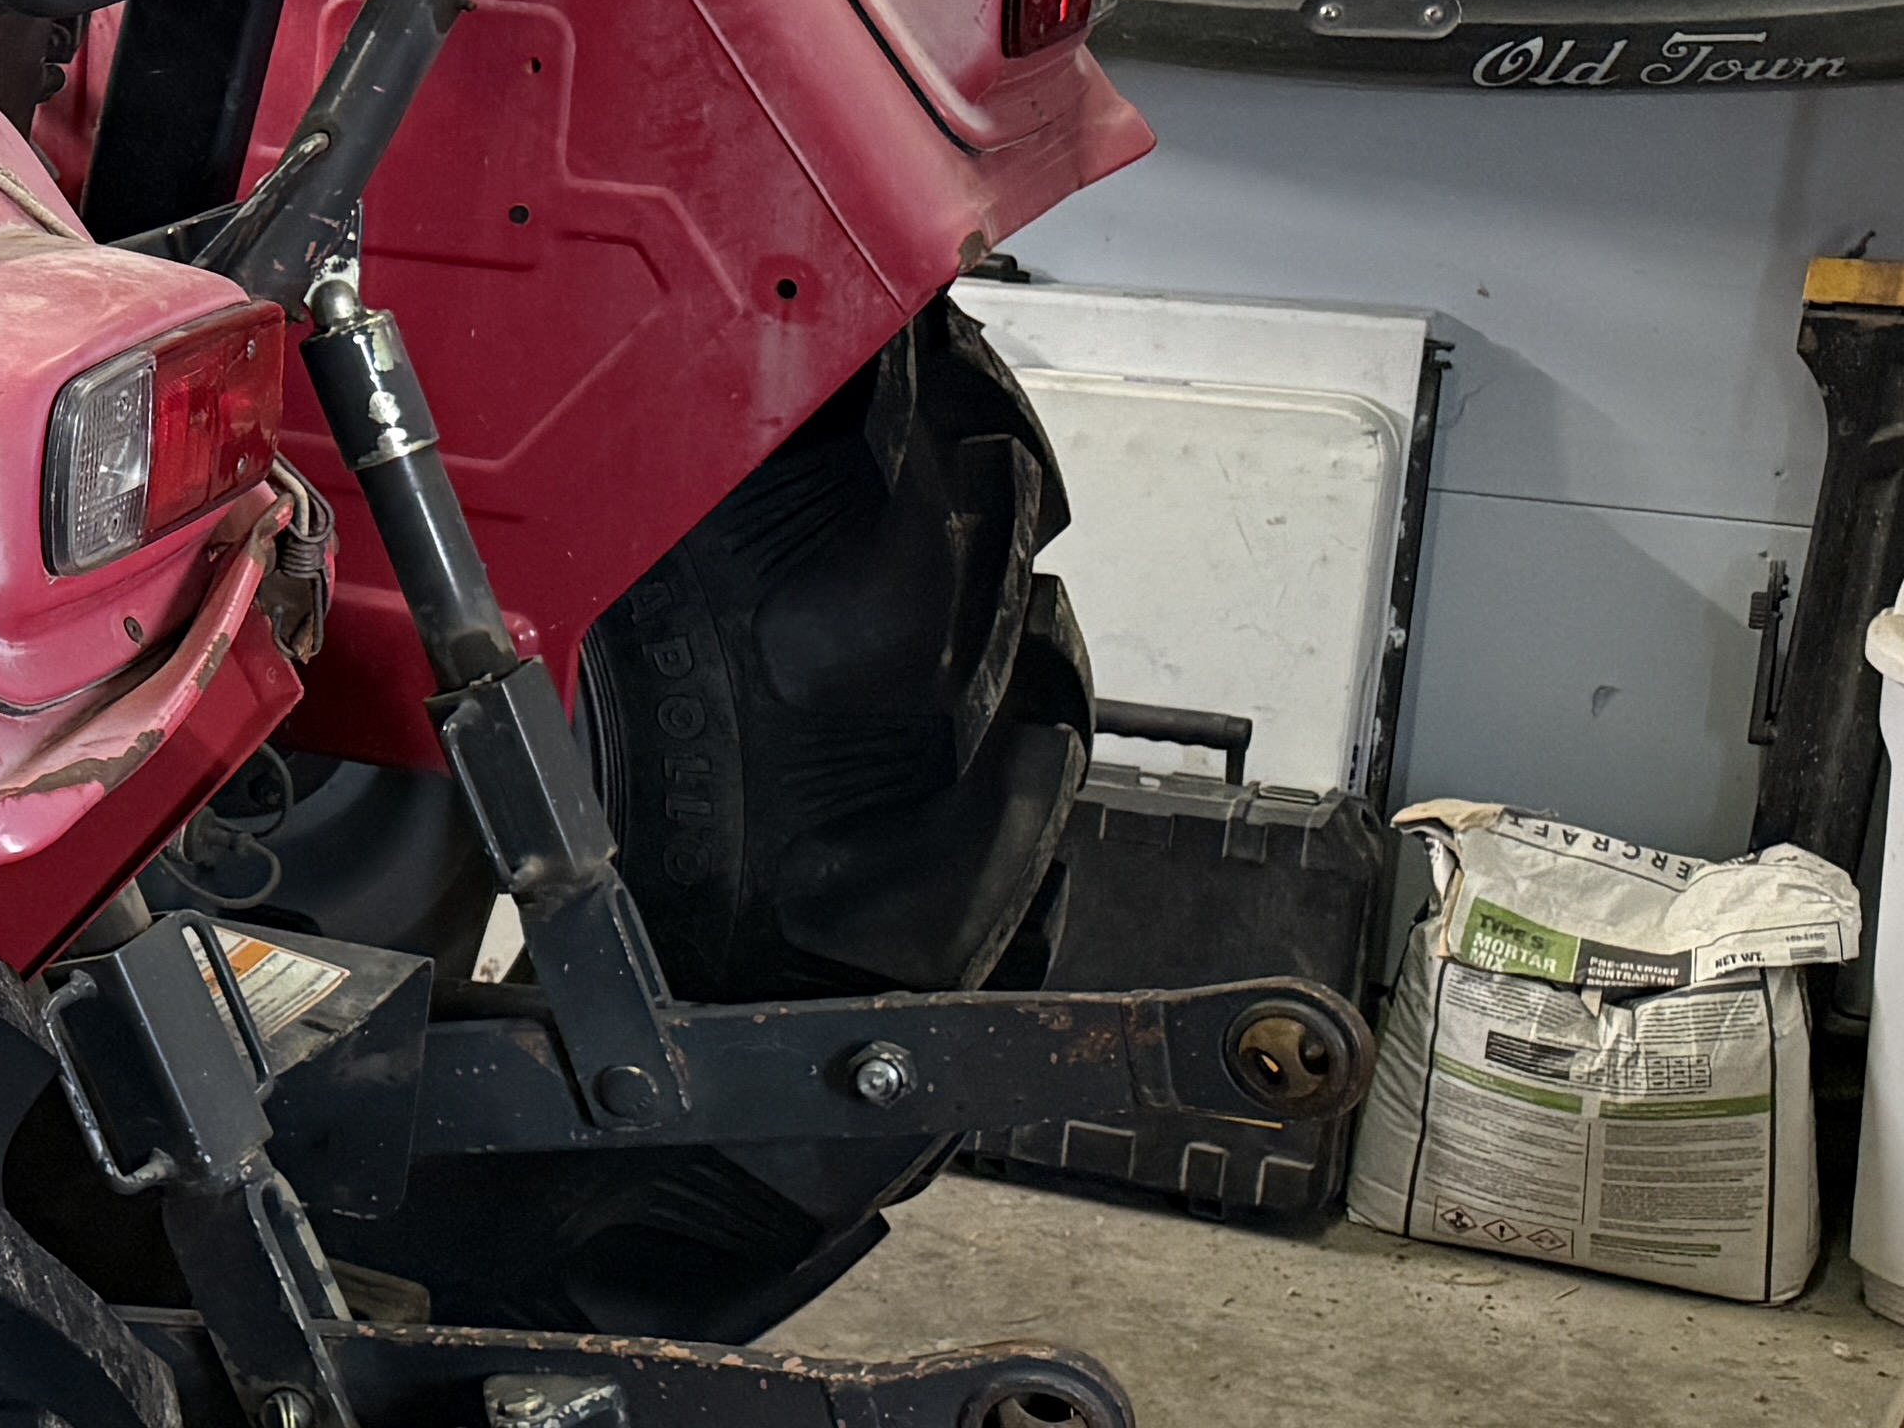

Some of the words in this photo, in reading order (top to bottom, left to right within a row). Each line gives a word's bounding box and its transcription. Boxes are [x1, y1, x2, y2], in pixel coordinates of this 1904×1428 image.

[1472, 36, 1629, 87] Old
[1640, 31, 1848, 84] Town
[1477, 912, 1525, 945] TYPE
[1526, 933, 1546, 951] S
[1469, 948, 1507, 972] MIX
[1472, 932, 1558, 974] MORTAR
[1714, 952, 1739, 969] NET
[1739, 948, 1766, 966] WT.
[1587, 966, 1676, 987] CONTRACTOR
